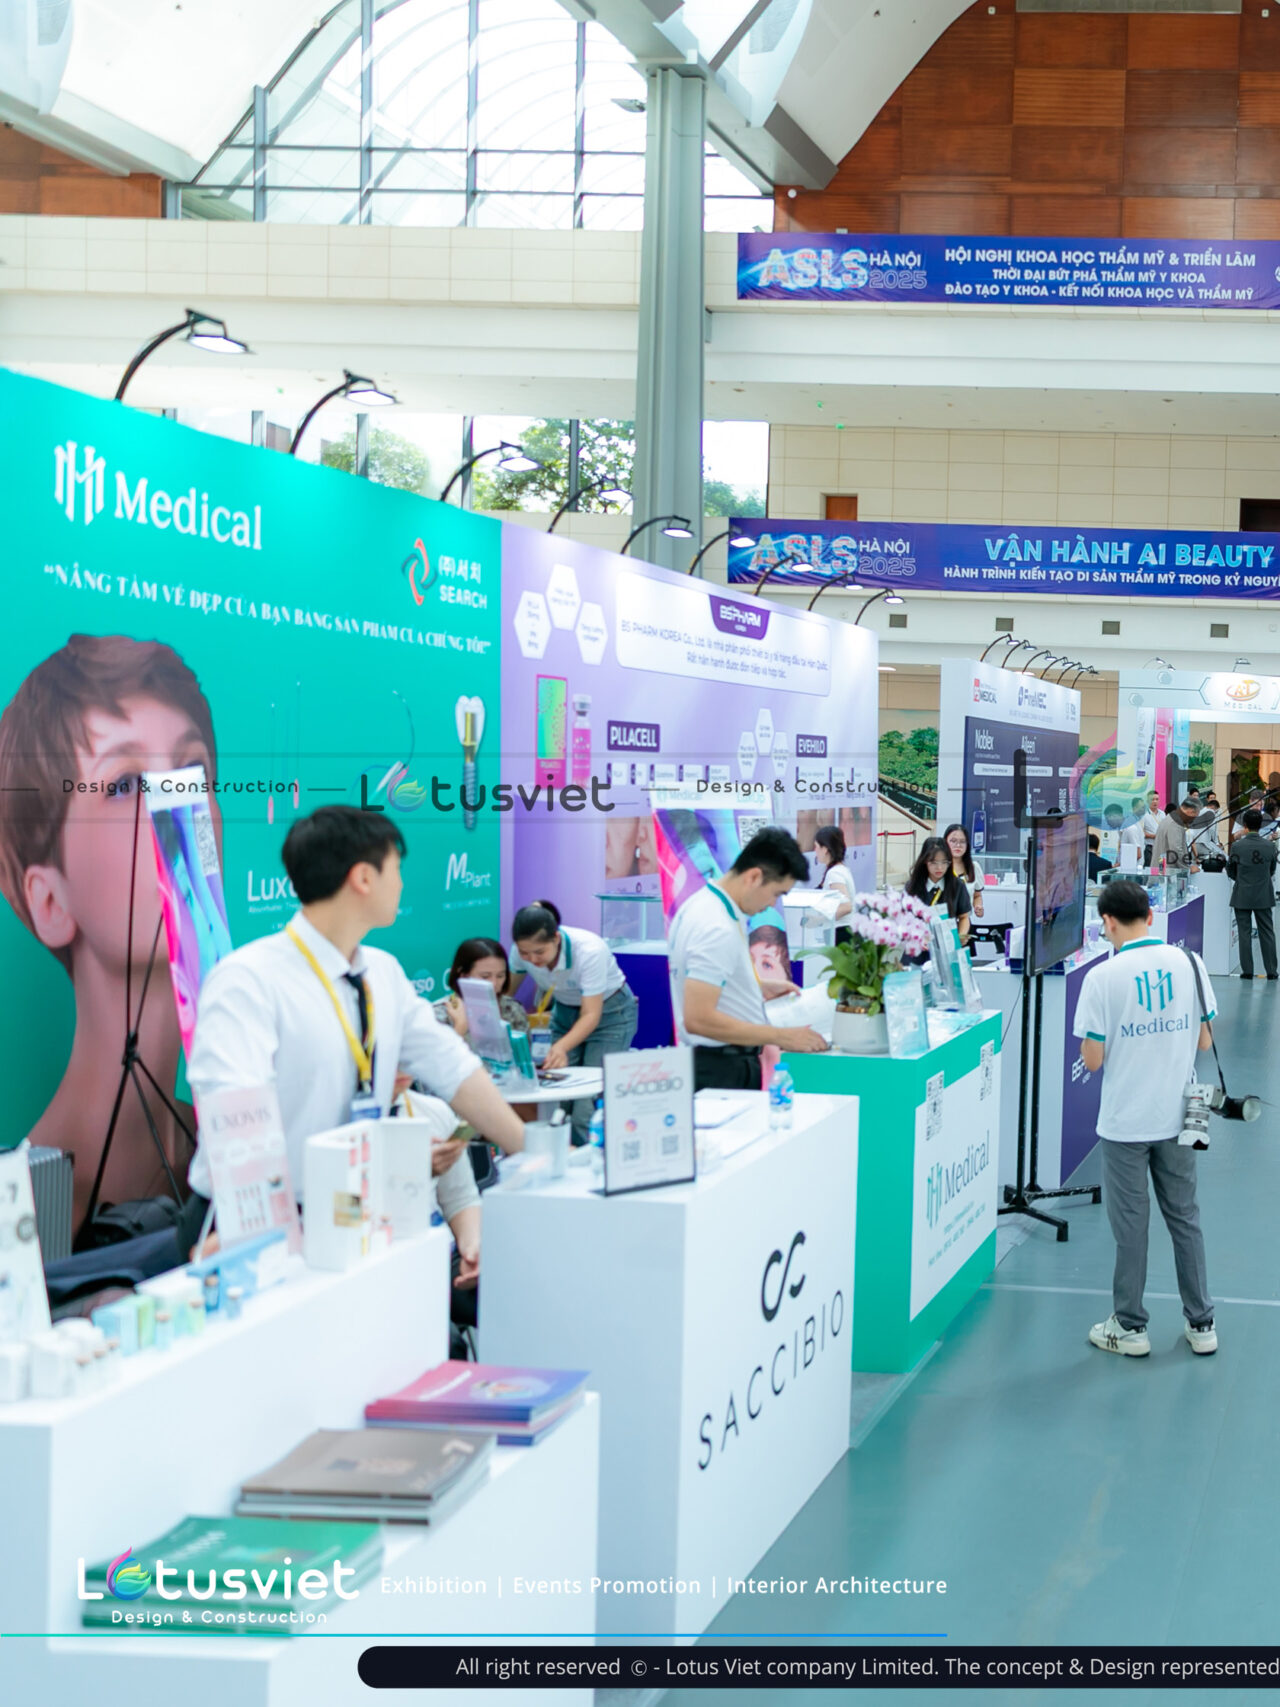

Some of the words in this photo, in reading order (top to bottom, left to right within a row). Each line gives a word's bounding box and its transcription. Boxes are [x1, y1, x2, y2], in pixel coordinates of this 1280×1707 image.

[869, 251, 893, 267] HÀ
[895, 250, 922, 269] NỘI
[944, 246, 972, 265] HỘI
[975, 249, 1012, 267] NGHỊ
[1016, 251, 1058, 264] KHOA
[1061, 251, 1095, 267] HỌC
[1099, 246, 1139, 265] THẨM
[1143, 249, 1166, 266] MỸ
[1183, 247, 1221, 267] TRIỂN
[1225, 252, 1256, 267] LÃM
[757, 247, 869, 290] ASLS
[992, 268, 1021, 281] THỜI
[1023, 269, 1047, 283] ĐẠI
[1048, 268, 1070, 281] BỨT
[1073, 268, 1098, 282] PHÁ
[1101, 267, 1136, 283] THẨM
[1138, 270, 1157, 283] MỸ
[1170, 272, 1206, 284] KHOA
[868, 269, 928, 290] 2025
[944, 281, 973, 296] ĐÀO
[975, 284, 1000, 298] TẠO
[1058, 283, 1079, 297] KẾT
[1081, 282, 1105, 297] NỐI
[1107, 286, 1143, 299] KHOA
[1145, 287, 1174, 301] HỌC
[1177, 286, 1195, 299] VÀ
[1198, 284, 1232, 300] THẨM
[1235, 287, 1254, 300] MỸ
[114, 470, 262, 550] Medical
[858, 538, 881, 553] HÀ
[884, 538, 910, 557] NỘI
[984, 533, 1043, 568] VẬN
[1051, 534, 1129, 565] HÀNH
[1138, 543, 1166, 566] AI
[1175, 544, 1275, 569] BEAUTY
[858, 556, 917, 576] 2025
[943, 566, 980, 580] HÀNH
[982, 566, 1016, 581] TRÌNH
[1019, 565, 1047, 581] KIẾN
[1049, 570, 1075, 583] TẠO
[1093, 569, 1118, 583] SẢN
[1120, 567, 1155, 584] THẨM
[1157, 570, 1176, 585] MỸ
[1179, 573, 1221, 586] TRONG
[1224, 571, 1241, 586] KỶ
[439, 585, 488, 609] SEARCH
[261, 602, 291, 626] BẠN
[660, 627, 682, 642] KOREA
[609, 725, 657, 747] PLLACELL
[798, 738, 825, 754] EVEHILO
[1121, 1013, 1190, 1039] Medical
[944, 1129, 990, 1205] Medical
[698, 1289, 844, 1472] SACCIBIO
